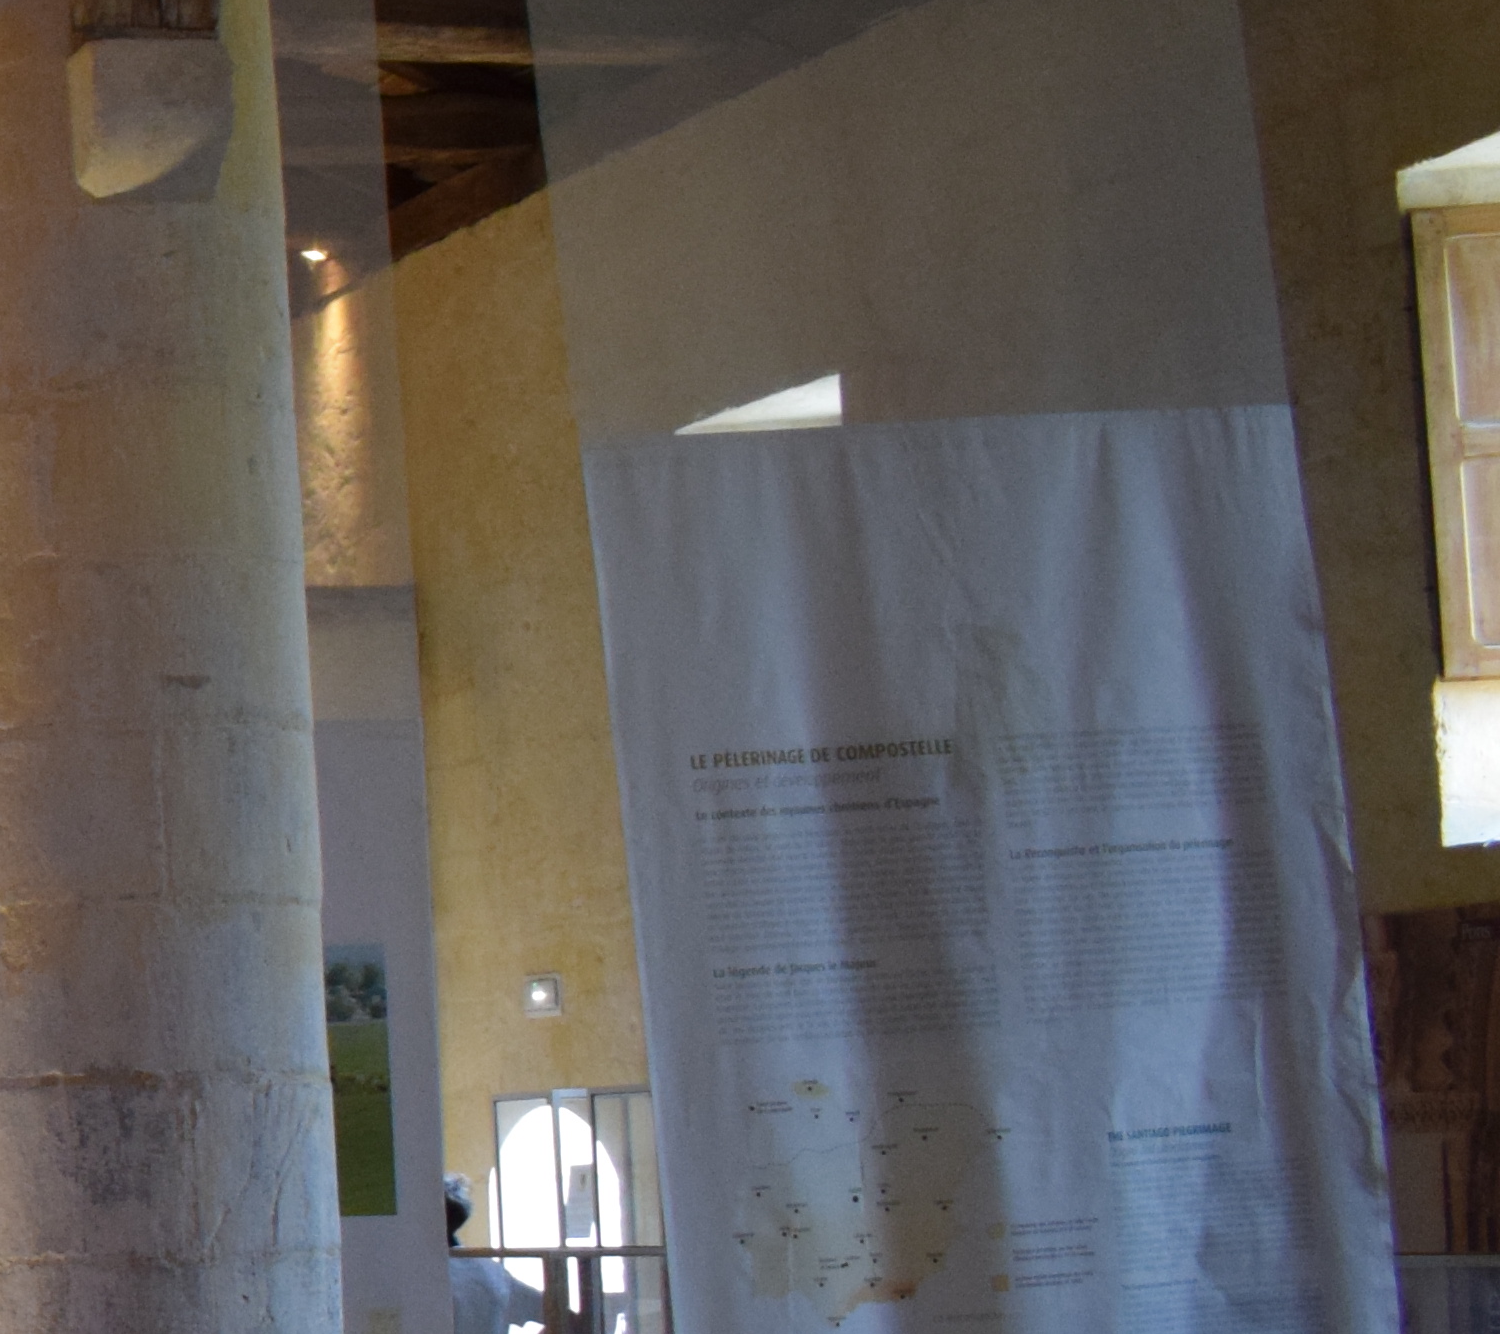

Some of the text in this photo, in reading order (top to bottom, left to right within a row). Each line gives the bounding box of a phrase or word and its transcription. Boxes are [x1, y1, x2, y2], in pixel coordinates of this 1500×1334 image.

[690, 754, 707, 770] LE
[811, 746, 830, 763] DE
[836, 738, 952, 762] COMPOSTELLE
